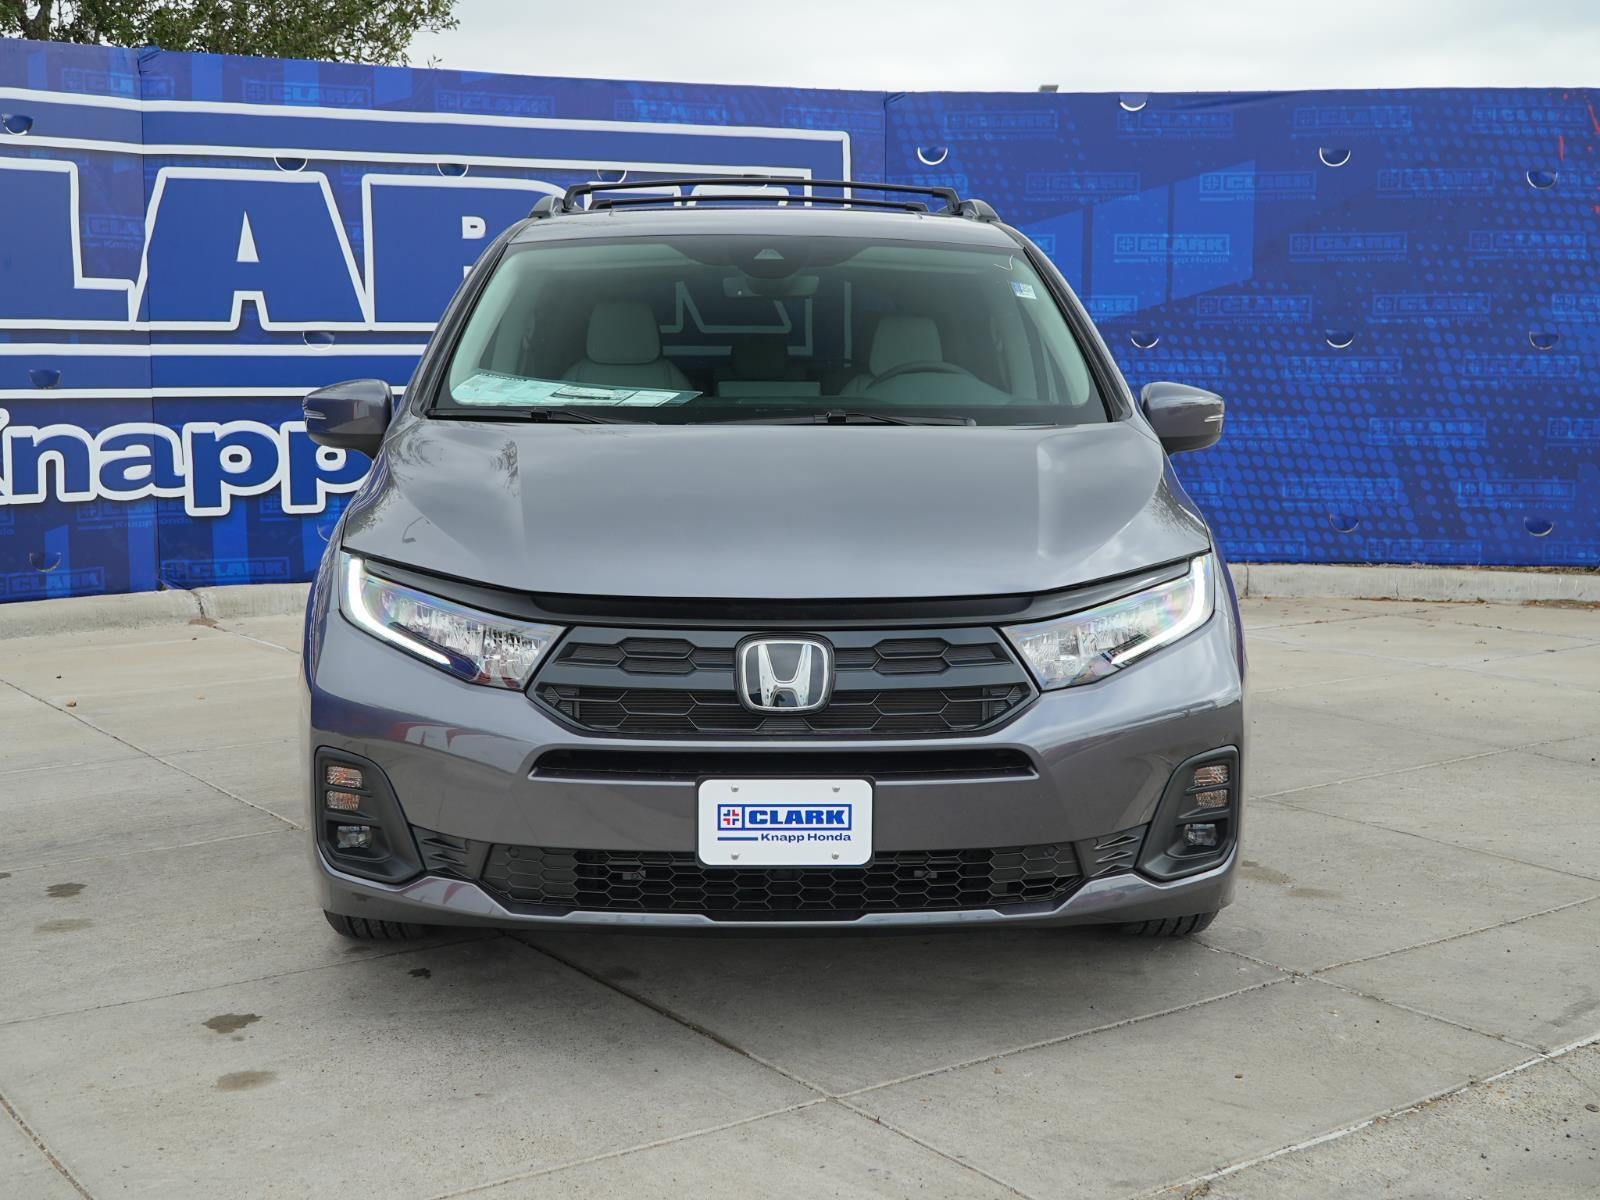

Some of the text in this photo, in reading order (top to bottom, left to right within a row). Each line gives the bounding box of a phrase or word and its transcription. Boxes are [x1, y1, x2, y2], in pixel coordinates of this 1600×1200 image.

[0, 407, 374, 517] napp
[748, 809, 846, 825] CLARK
[761, 832, 851, 843] Knapp Honda
